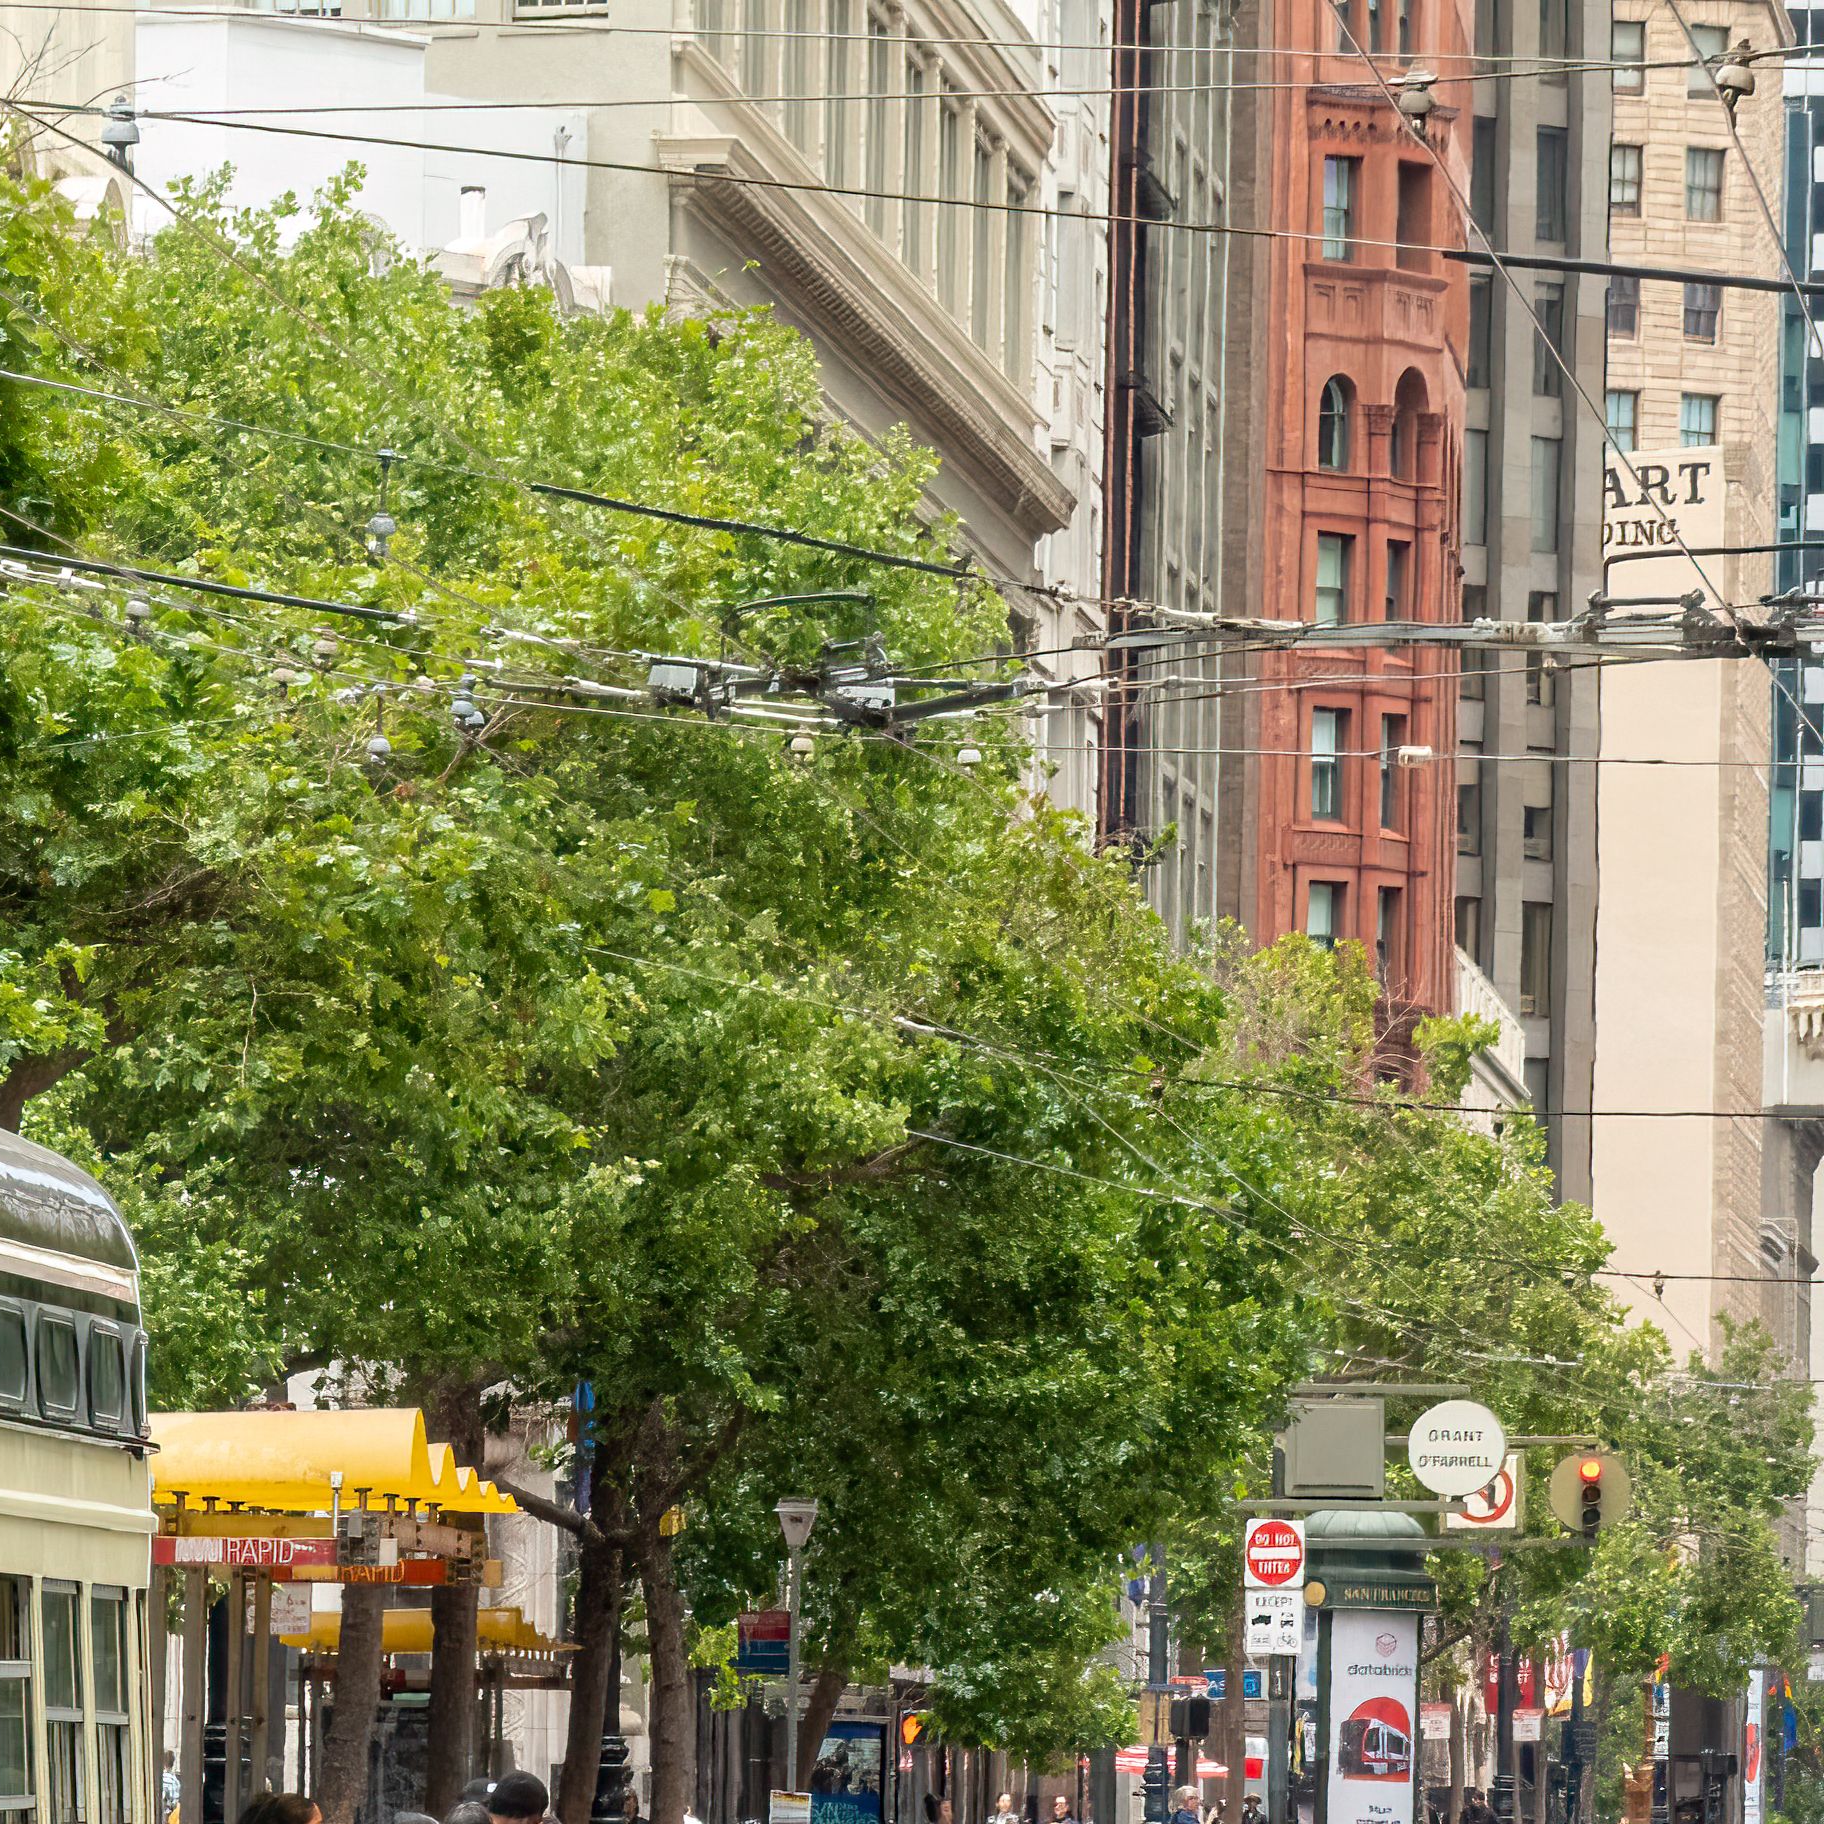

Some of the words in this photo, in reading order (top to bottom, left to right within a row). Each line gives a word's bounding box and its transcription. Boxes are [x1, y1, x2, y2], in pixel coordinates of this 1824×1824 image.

[1428, 1429, 1484, 1442] GRANT
[1419, 1455, 1493, 1468] O'FARRELL
[1255, 1533, 1269, 1546] DO
[1274, 1533, 1295, 1546] NOT
[226, 1538, 294, 1564] RAPID
[1258, 1561, 1290, 1574] ENTER
